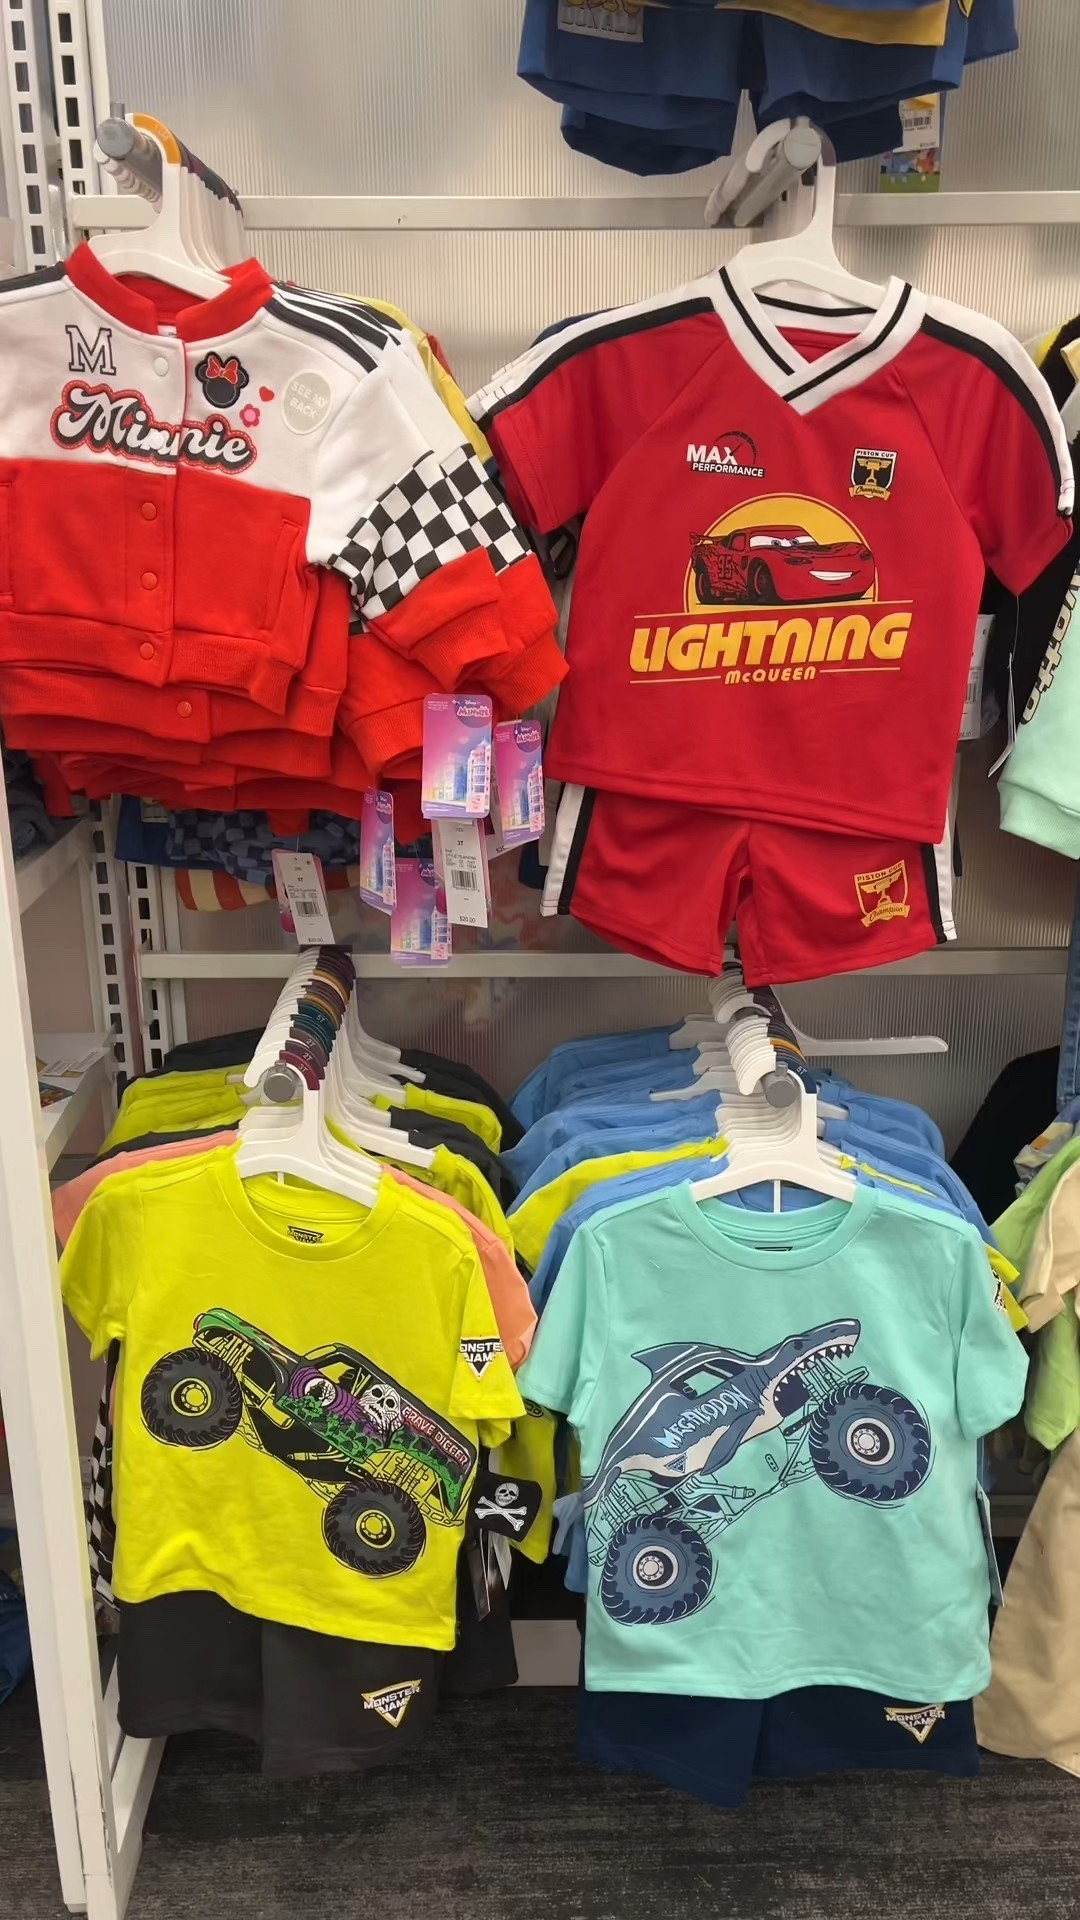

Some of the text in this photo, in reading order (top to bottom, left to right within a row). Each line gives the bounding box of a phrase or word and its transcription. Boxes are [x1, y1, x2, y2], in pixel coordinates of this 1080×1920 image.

[65, 325, 116, 375] M
[290, 381, 328, 409] SEE MY
[290, 397, 319, 420] BACK
[55, 386, 253, 466] Minnie
[686, 444, 738, 465] MAX
[692, 462, 764, 477] PERFORMANCE
[855, 486, 885, 495] Champion
[718, 554, 733, 580] 95
[629, 612, 912, 673] LIGHTNING
[856, 862, 903, 881] PISTON CUP
[869, 906, 904, 921] Champion
[315, 1014, 326, 1023] 5T
[305, 1038, 315, 1048] 2T
[302, 1051, 313, 1061] 2T
[299, 1063, 308, 1073] 3T
[795, 1066, 807, 1076] 5T
[459, 1342, 504, 1352] ONSTE
[466, 1351, 494, 1362] JAM
[650, 1383, 754, 1448] MEGALODON
[401, 1406, 468, 1466] GRAVE DIGGER
[363, 1686, 420, 1709] MONSTER
[381, 1697, 407, 1714] JAM
[885, 1709, 946, 1721] MONSTER
[903, 1717, 932, 1728] JAM
